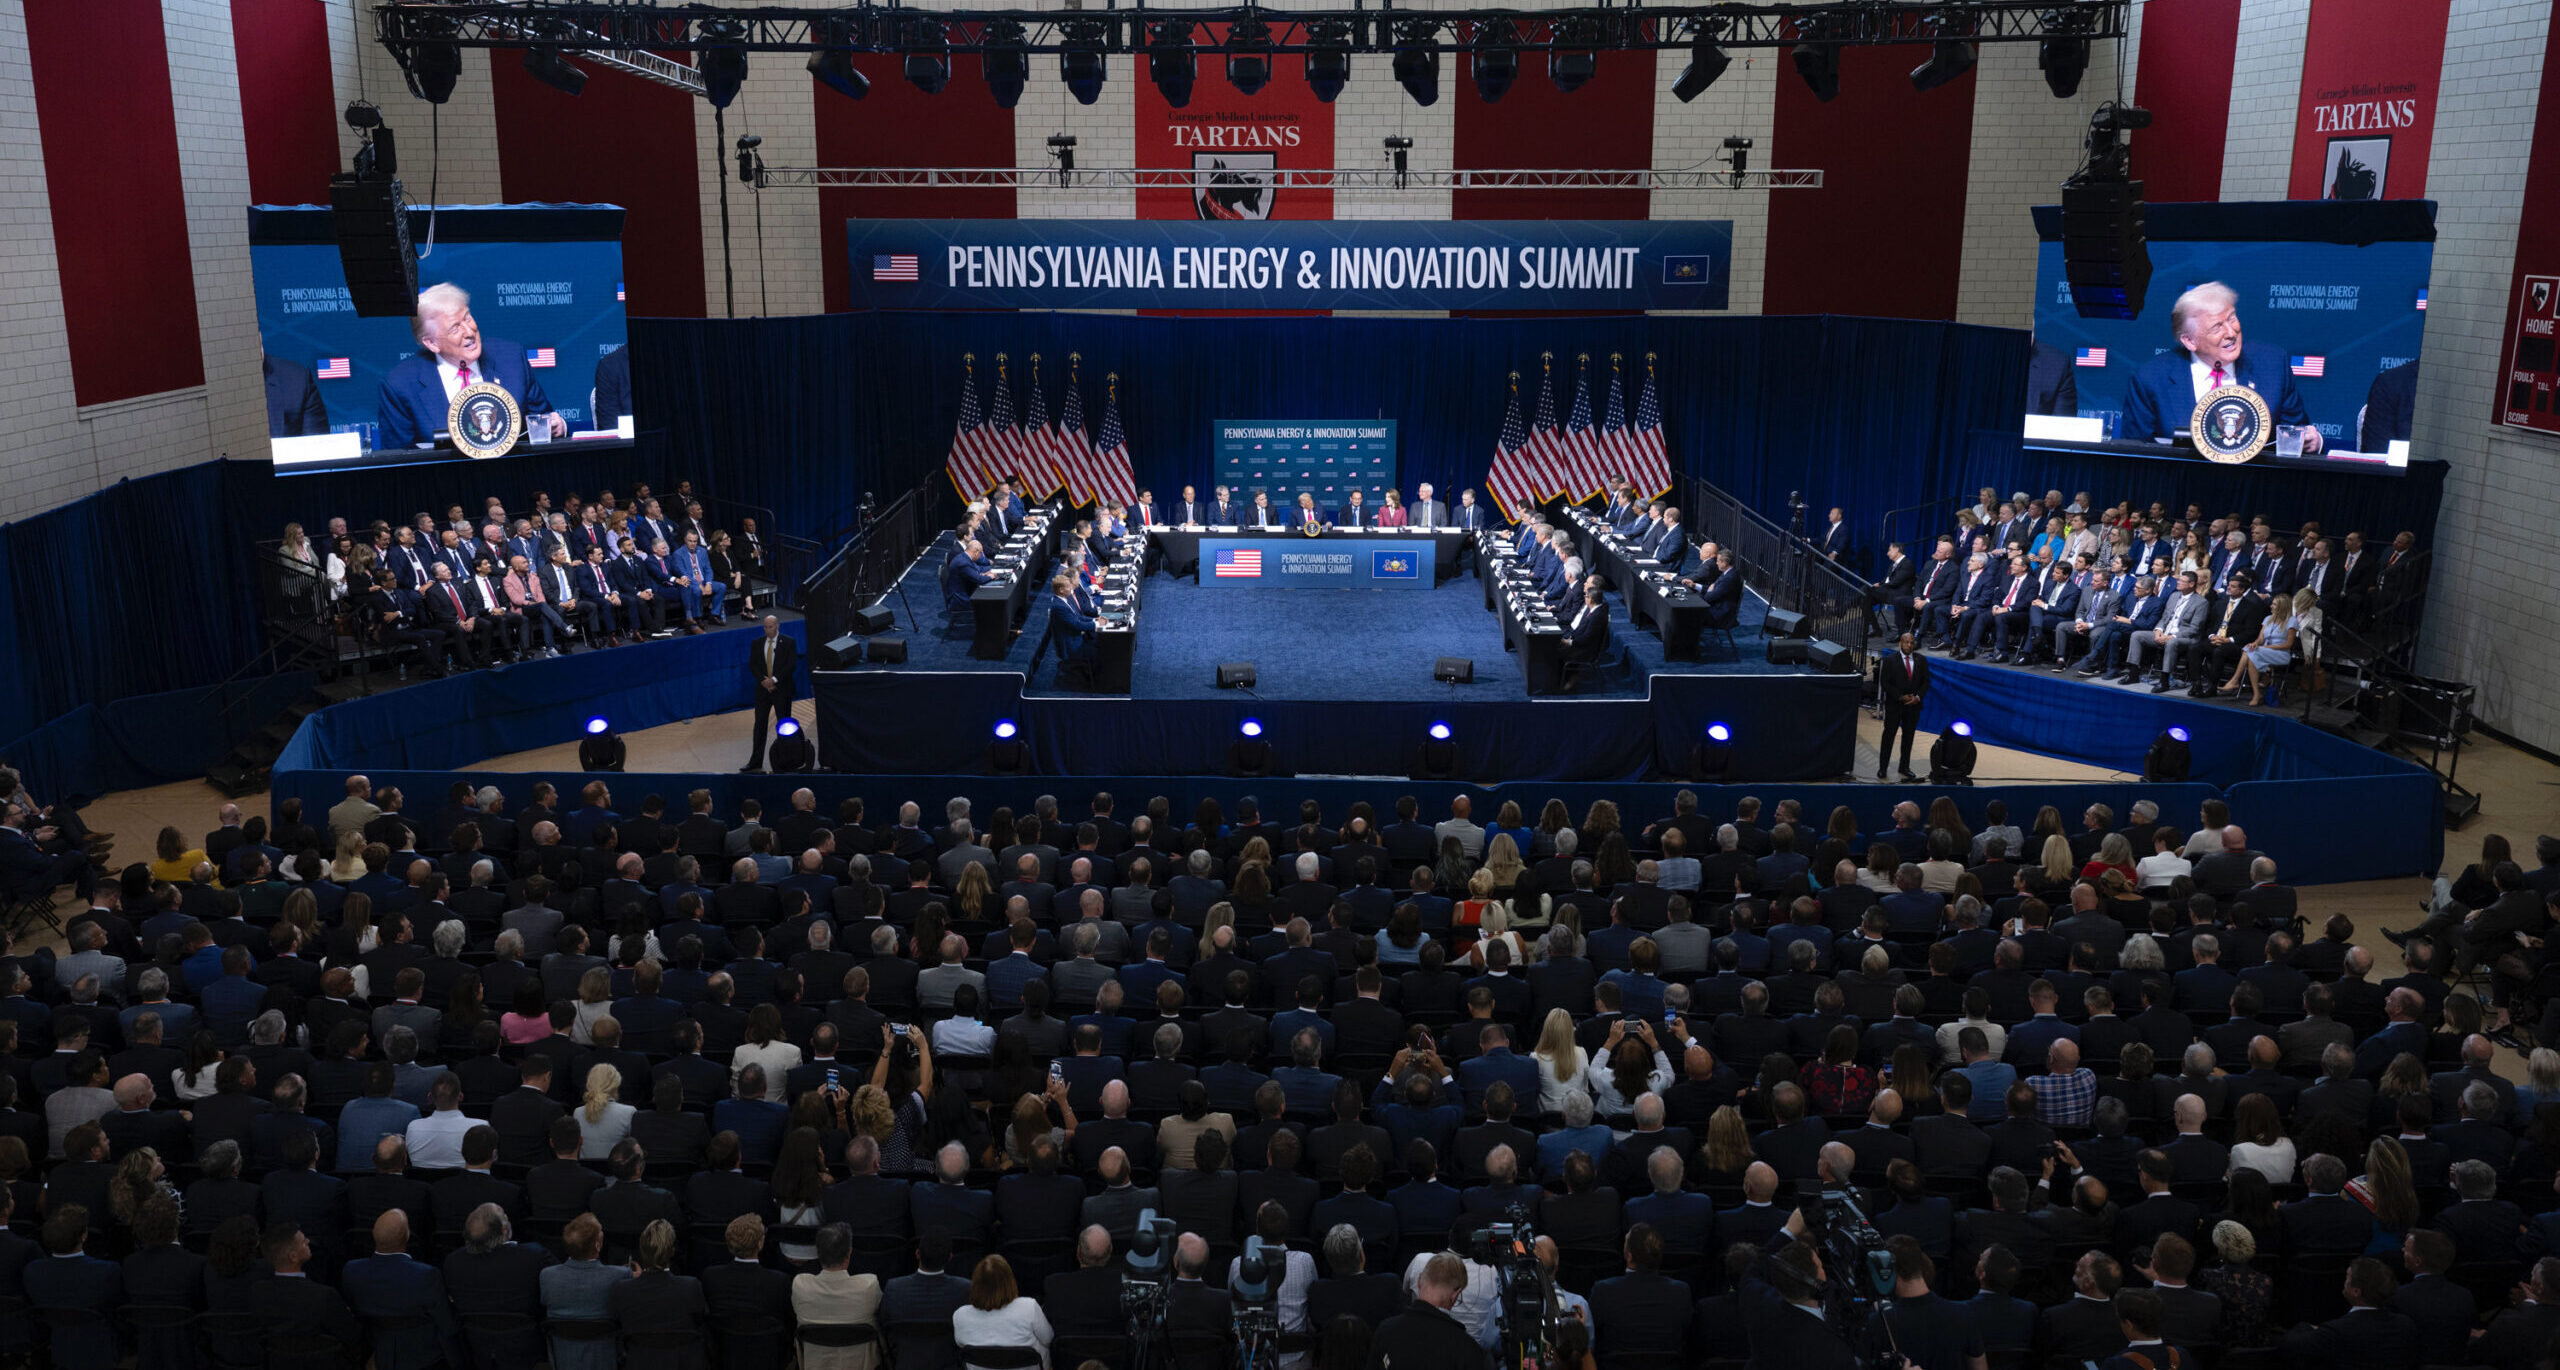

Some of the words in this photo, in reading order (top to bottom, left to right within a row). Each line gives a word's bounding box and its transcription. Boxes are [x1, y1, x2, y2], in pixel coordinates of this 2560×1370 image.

[2314, 99, 2416, 132] TARTANS
[1168, 125, 1300, 147] TARTANS
[948, 246, 1165, 288] PENNSYLVANIA
[1173, 247, 1289, 289] ENERGY
[1296, 250, 1321, 289] &
[1330, 246, 1510, 289] INNOVATION
[1519, 246, 1640, 289] SUMMIT
[282, 288, 337, 300] PENNSYLVANIA
[497, 282, 545, 294] PENNSYLVANIA
[546, 282, 572, 293] ENERGY
[2270, 284, 2326, 296] PENNSYLVANIA
[2328, 286, 2360, 297] ENERGY
[498, 296, 504, 306] &
[505, 294, 545, 306] INNOVATION
[547, 293, 573, 305] SUMMIT
[2268, 298, 2275, 308] &
[2276, 298, 2324, 310] INNOVATION
[2326, 299, 2359, 310] SUMMIT
[283, 302, 290, 313] &
[292, 300, 338, 312] INNOVATION
[2526, 318, 2554, 334] HOME
[2514, 371, 2535, 383] FOULS
[450, 386, 480, 422] PRESIDENT
[501, 392, 519, 423] UNITED
[2194, 388, 2230, 422] PRESIDENT
[2254, 398, 2268, 431] UNITED
[2508, 411, 2528, 424] SCORE
[1224, 428, 1275, 438] PENNSYLVANIA
[1277, 428, 1304, 438] ENERGY
[1306, 429, 1312, 438] &
[1314, 428, 1356, 438] INNOVATION
[1358, 428, 1387, 438] SUMMIT
[495, 430, 516, 454] STATES
[2234, 438, 2263, 461] STATES
[1282, 554, 1326, 563] PENNSYLVANIA
[1328, 554, 1352, 564] ENERGY
[1282, 565, 1287, 573] &
[1289, 564, 1326, 574] INNOVATION
[1328, 564, 1352, 574] SUMMIT
